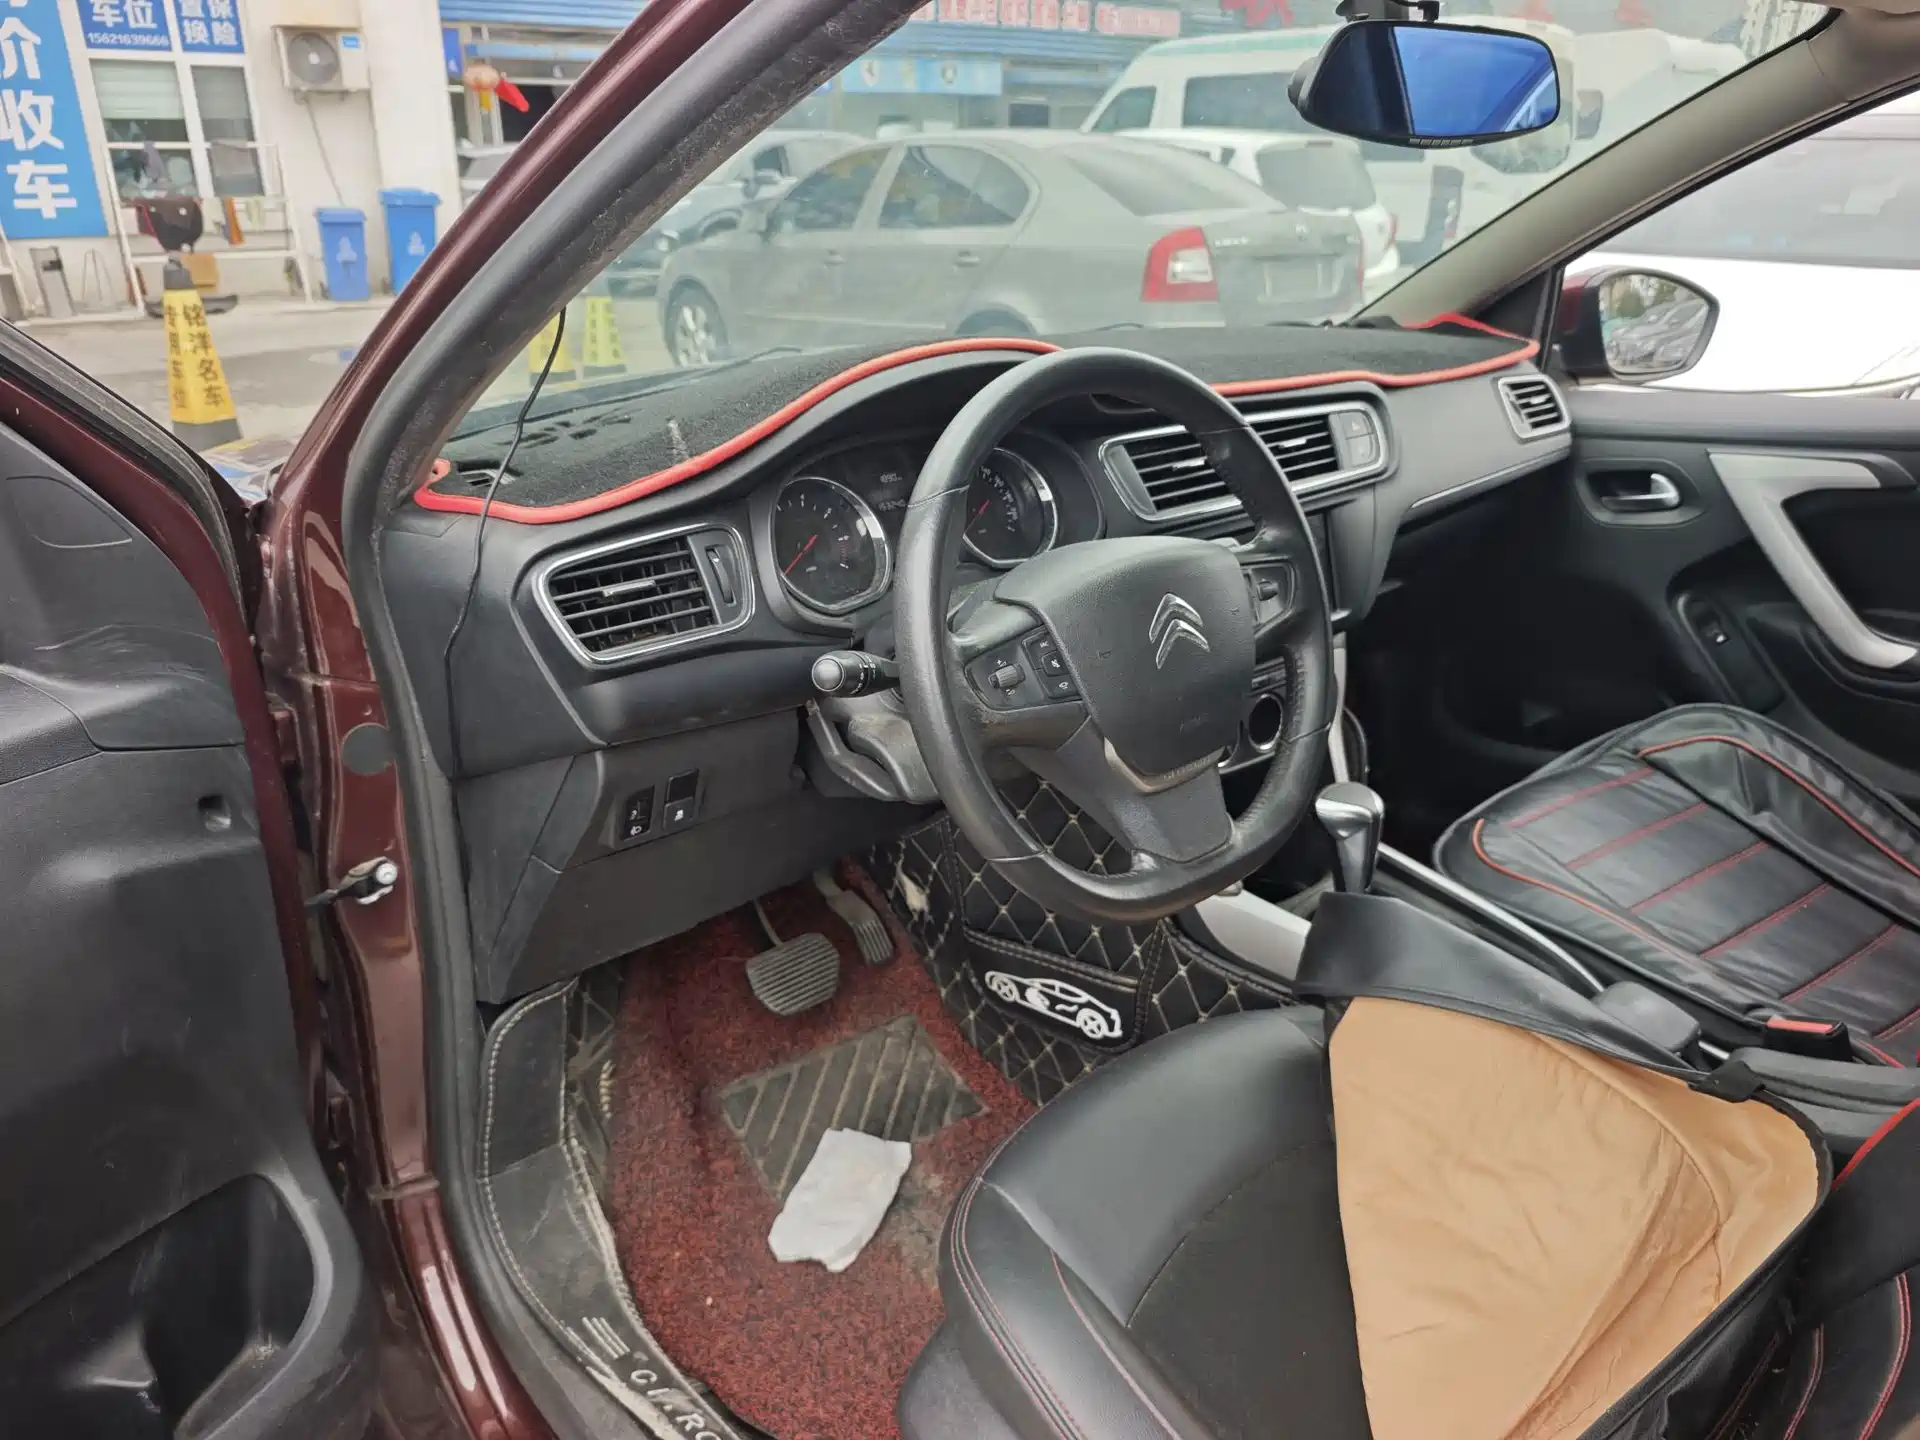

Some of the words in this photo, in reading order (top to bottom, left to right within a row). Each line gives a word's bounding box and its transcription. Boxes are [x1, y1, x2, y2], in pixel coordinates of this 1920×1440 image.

[91, 0, 157, 29] 车位
[0, 0, 78, 219] 价收车
